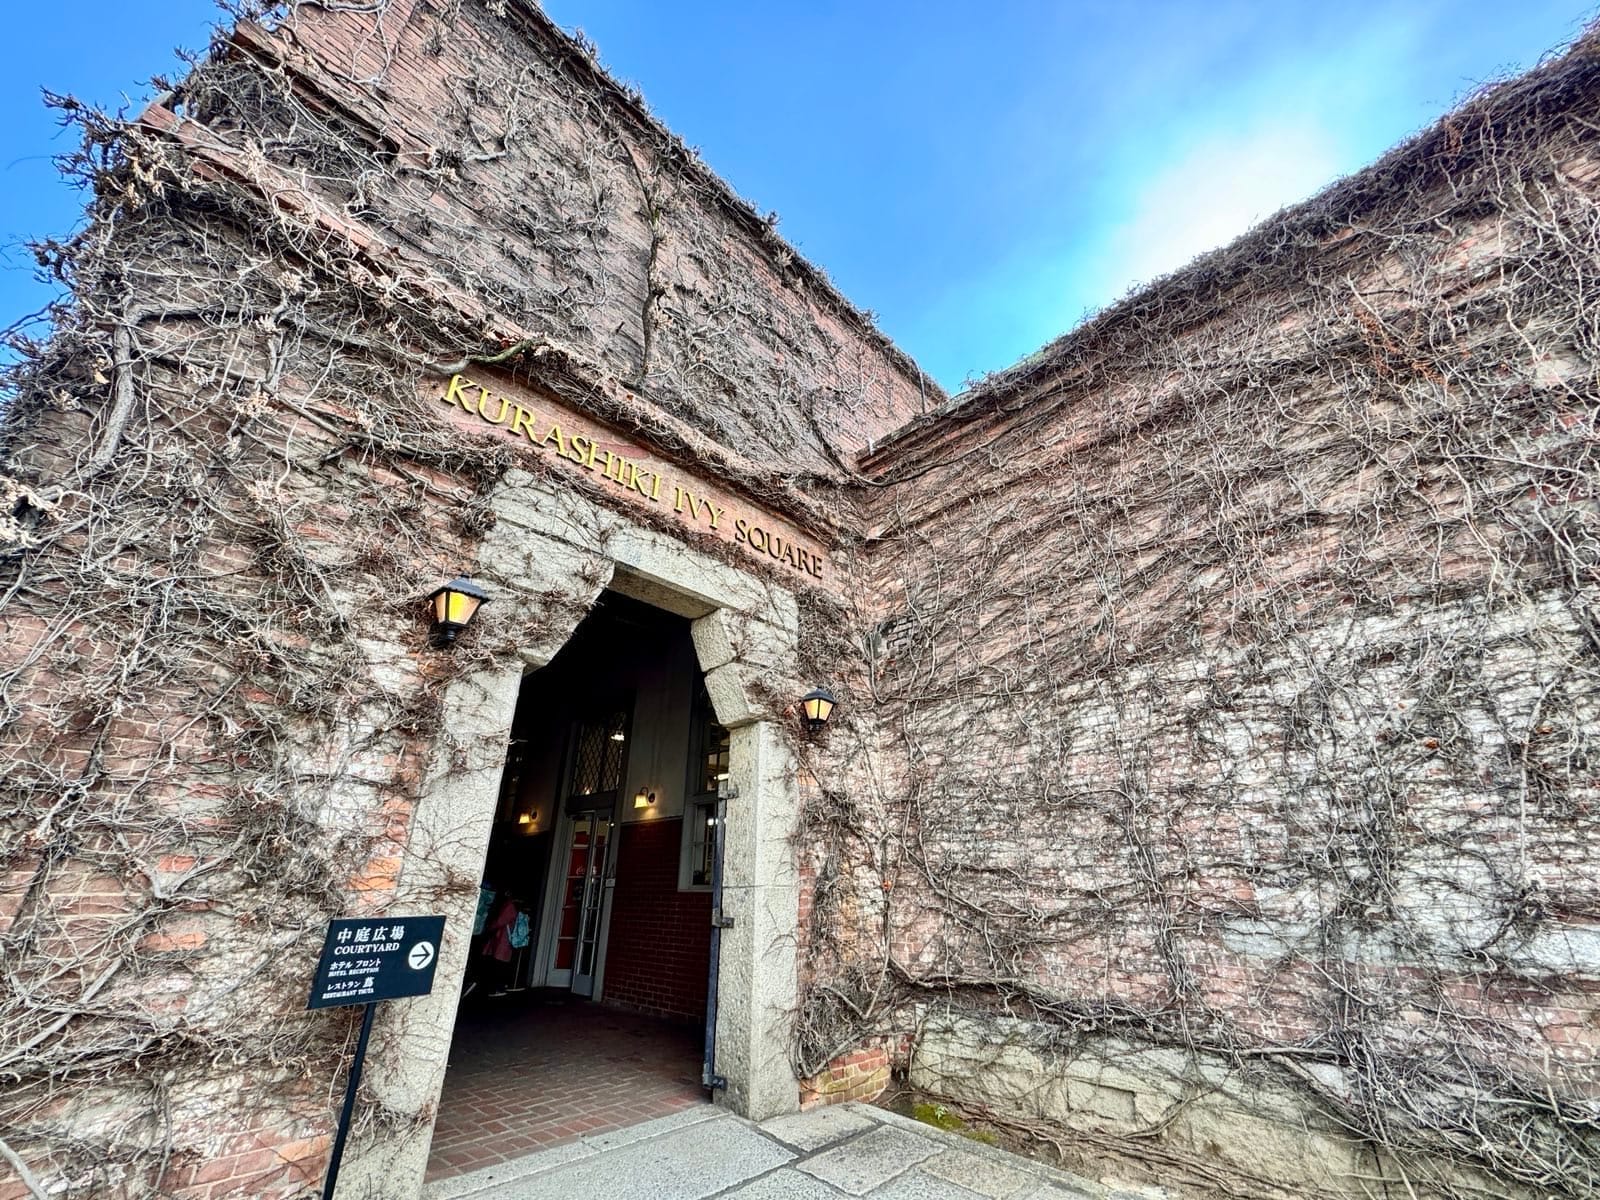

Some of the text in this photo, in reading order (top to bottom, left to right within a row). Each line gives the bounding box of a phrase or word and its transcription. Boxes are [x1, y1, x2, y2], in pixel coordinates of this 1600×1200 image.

[440, 374, 823, 579] KURASHIKI IVY SQUARE
[337, 925, 405, 943] 中庭広場
[334, 942, 400, 955] COURTYARD
[330, 957, 381, 970] ホテル フロント
[327, 980, 361, 990] レストラン
